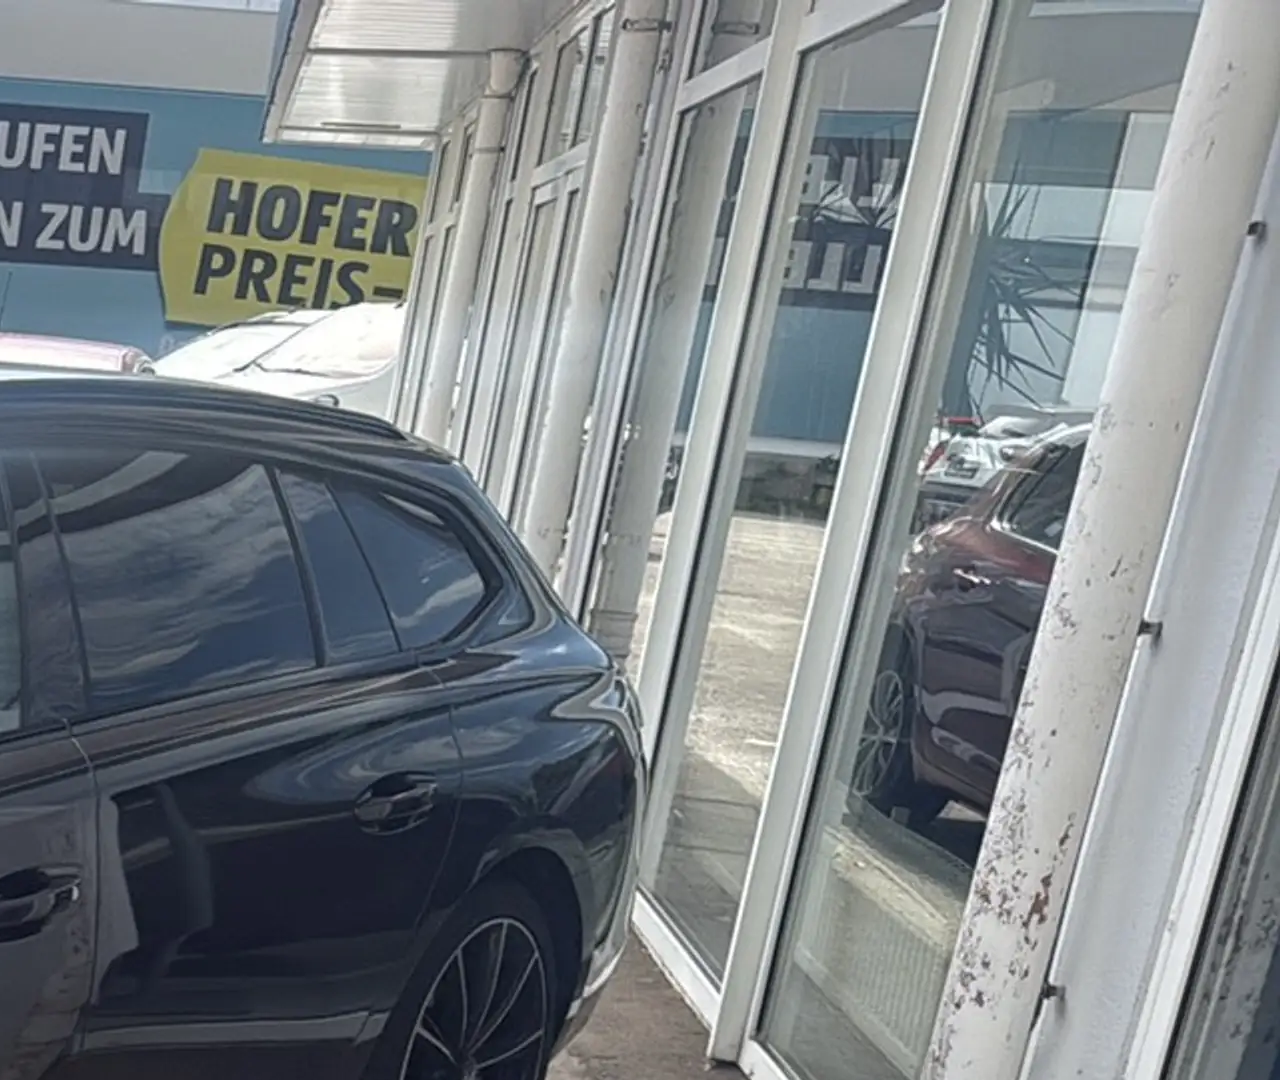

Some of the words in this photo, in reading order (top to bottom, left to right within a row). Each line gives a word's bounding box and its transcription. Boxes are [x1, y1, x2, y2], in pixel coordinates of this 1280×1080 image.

[35, 204, 148, 256] ZUM
[206, 177, 419, 258] HOFER
[193, 243, 404, 310] PREIS-
